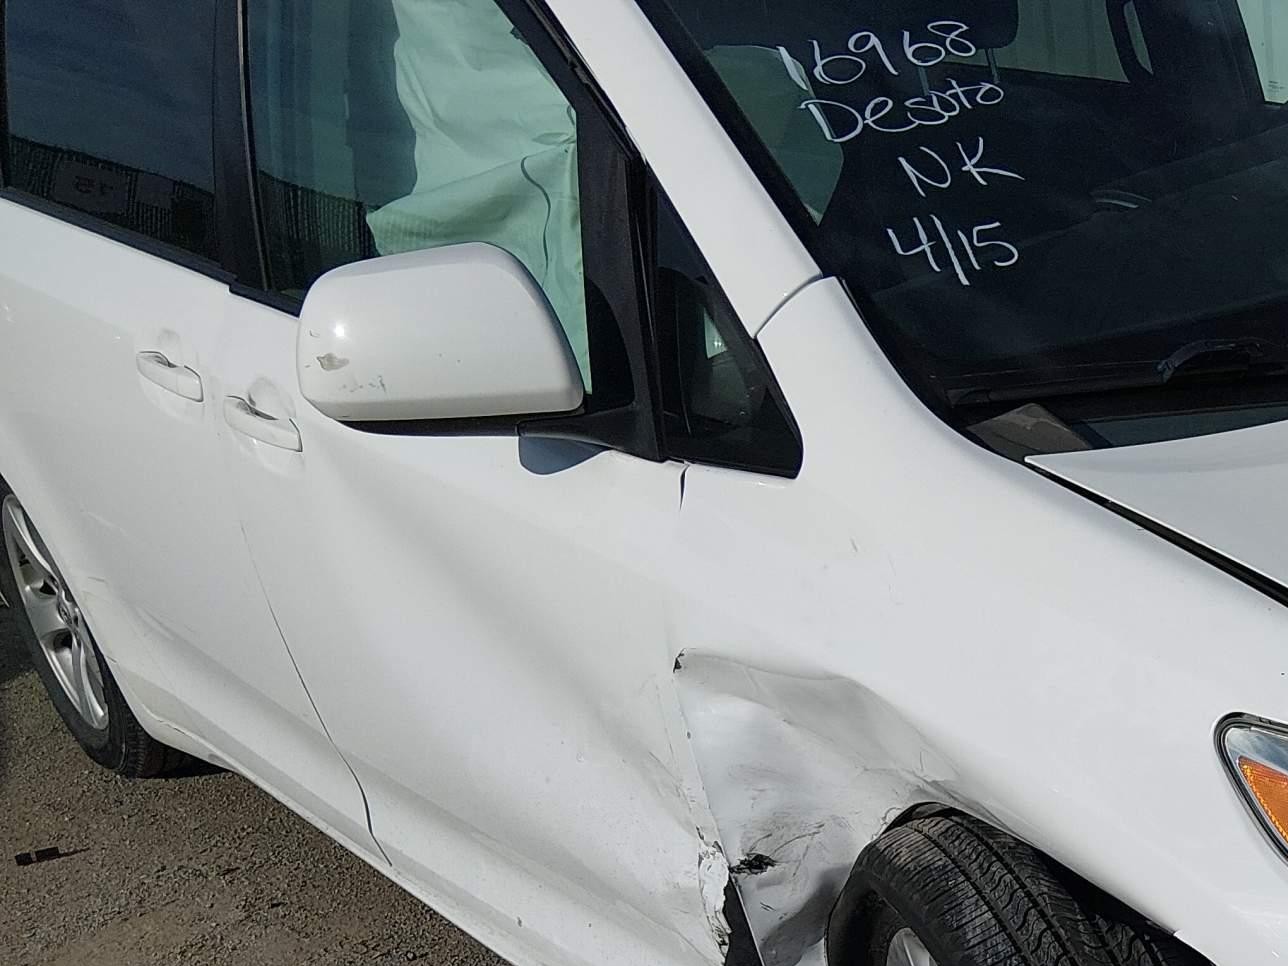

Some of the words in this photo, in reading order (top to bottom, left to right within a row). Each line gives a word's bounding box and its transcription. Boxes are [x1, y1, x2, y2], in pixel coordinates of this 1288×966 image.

[776, 20, 976, 90] 16968
[898, 136, 1025, 197] NK
[886, 214, 1019, 286] 4/15
